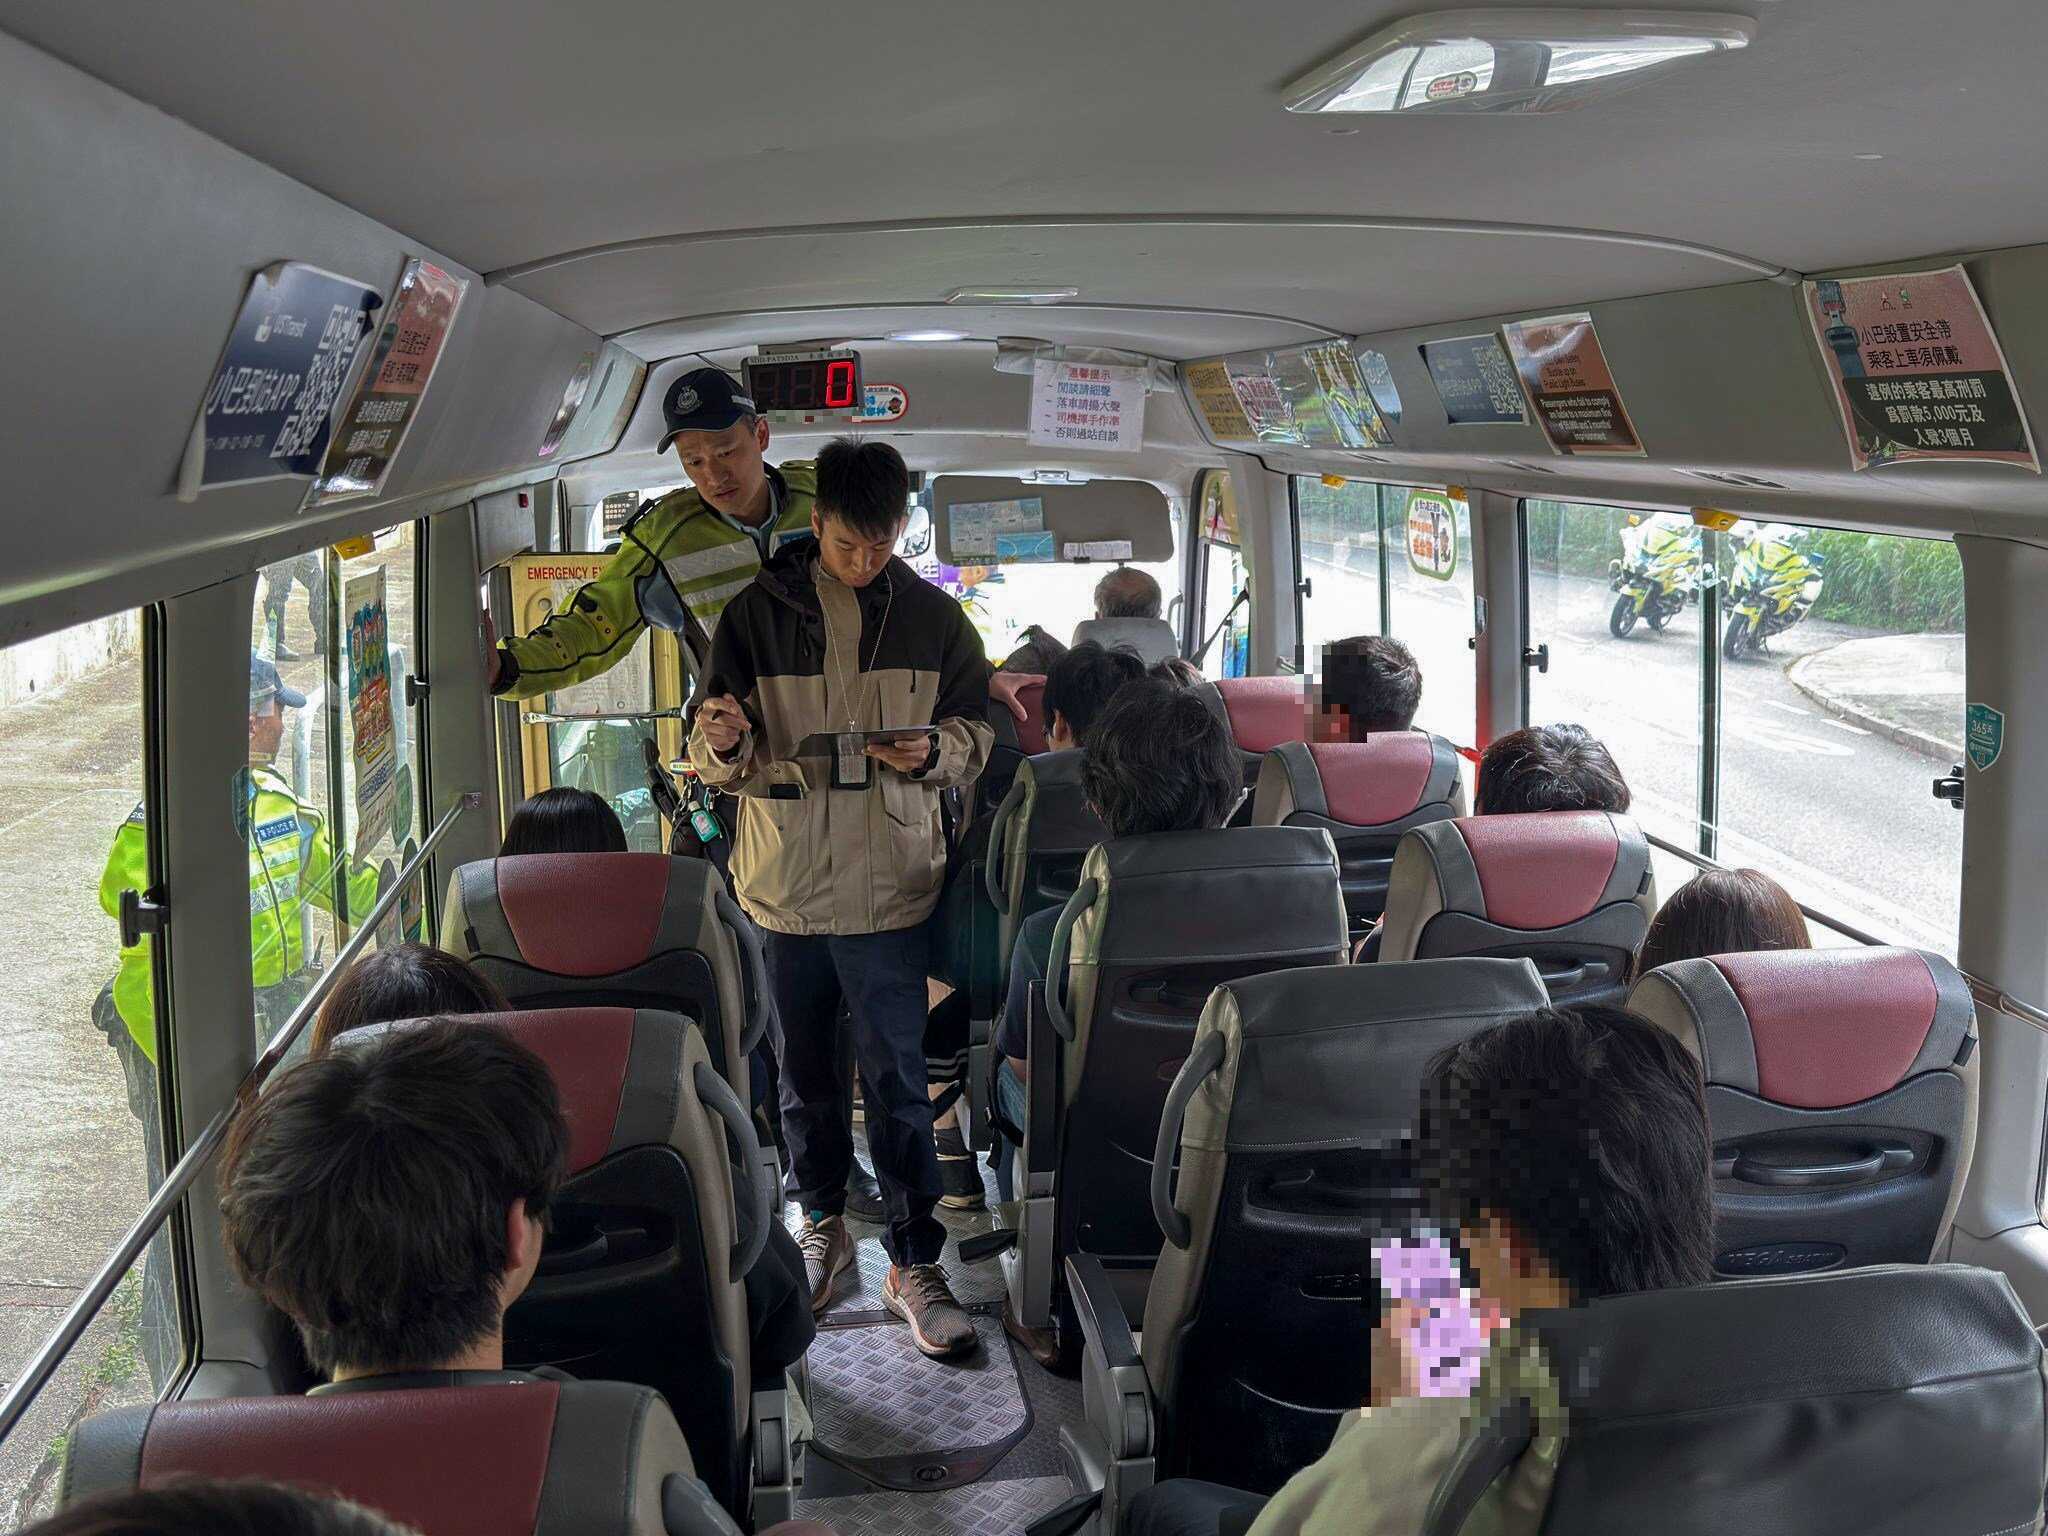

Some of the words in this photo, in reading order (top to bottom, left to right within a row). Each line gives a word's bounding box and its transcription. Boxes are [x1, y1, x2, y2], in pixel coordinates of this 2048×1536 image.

[1861, 319, 1952, 346] 小巴設置安全帶
[1867, 346, 1963, 369] 乘客上車須佩戴
[826, 361, 855, 407] 0
[1866, 378, 1987, 402] 違例的乘客最高刑罰
[1914, 428, 1975, 447] 入獄3個月
[527, 566, 588, 580] EMERGENCY
